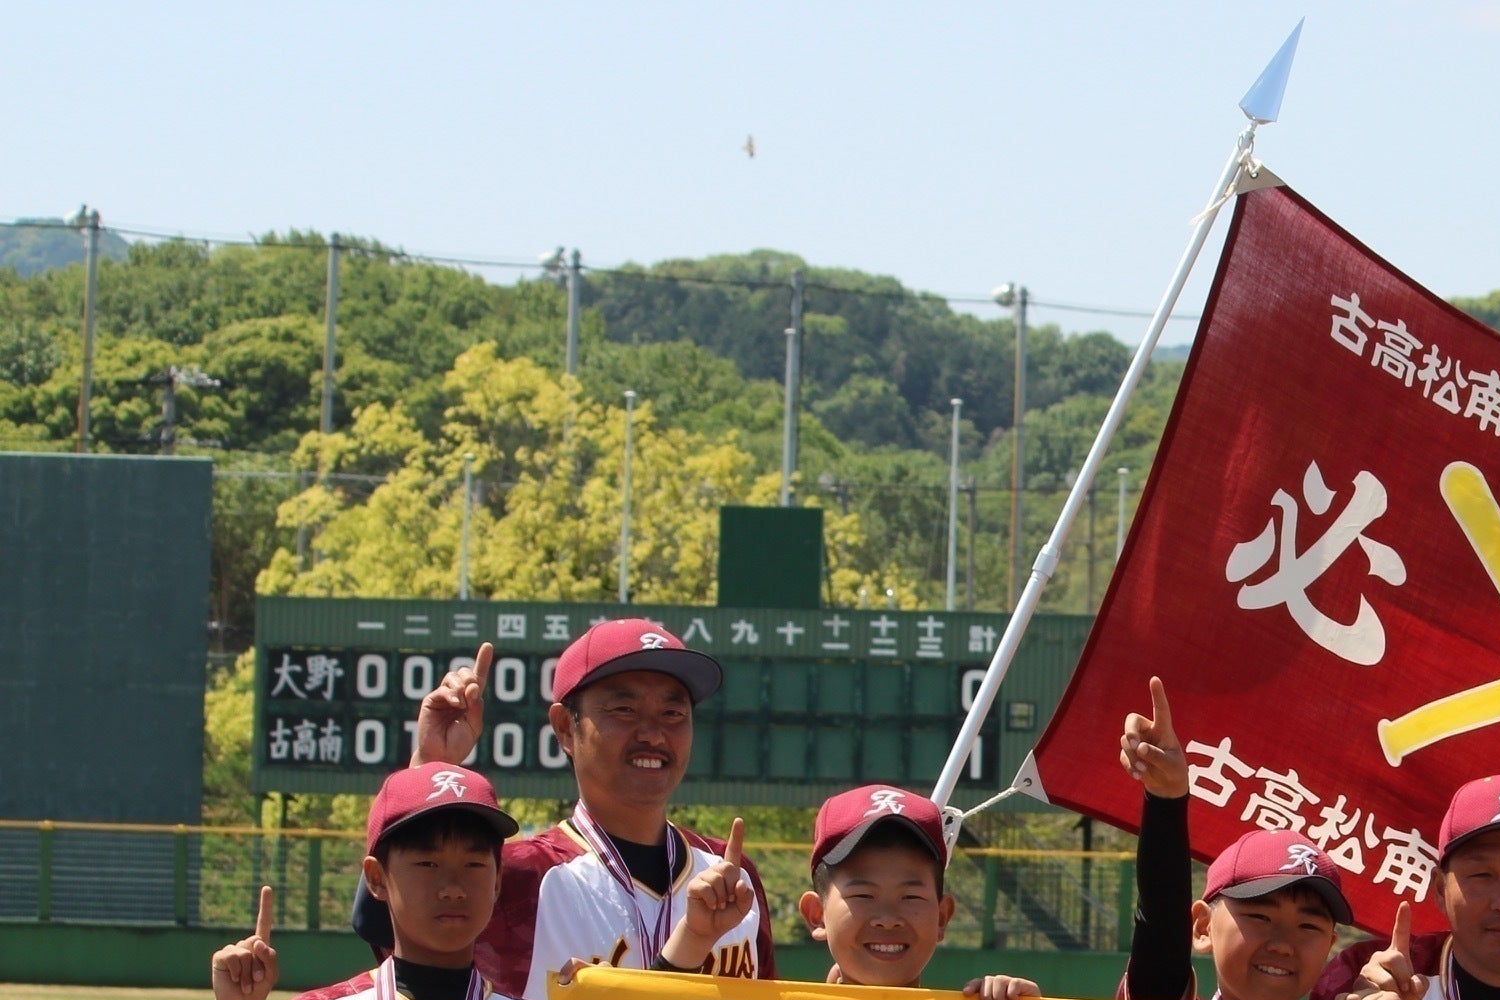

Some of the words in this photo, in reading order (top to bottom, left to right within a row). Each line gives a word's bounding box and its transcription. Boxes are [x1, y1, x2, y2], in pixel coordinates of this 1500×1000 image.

[1226, 460, 1405, 667] 必
[357, 622, 386, 630] 一
[404, 615, 431, 634] 二
[451, 613, 478, 637] 三
[497, 614, 526, 639] 四
[543, 615, 570, 640] 五
[683, 618, 712, 642] 八
[731, 620, 759, 644] 九
[777, 621, 803, 645] 十
[968, 624, 997, 652] 計
[271, 653, 344, 700] 大野
[356, 654, 388, 698] 0
[402, 655, 433, 700] 0
[494, 657, 525, 702] 0
[269, 718, 342, 764] 古高南
[355, 719, 385, 764] 0
[492, 722, 524, 767] 0
